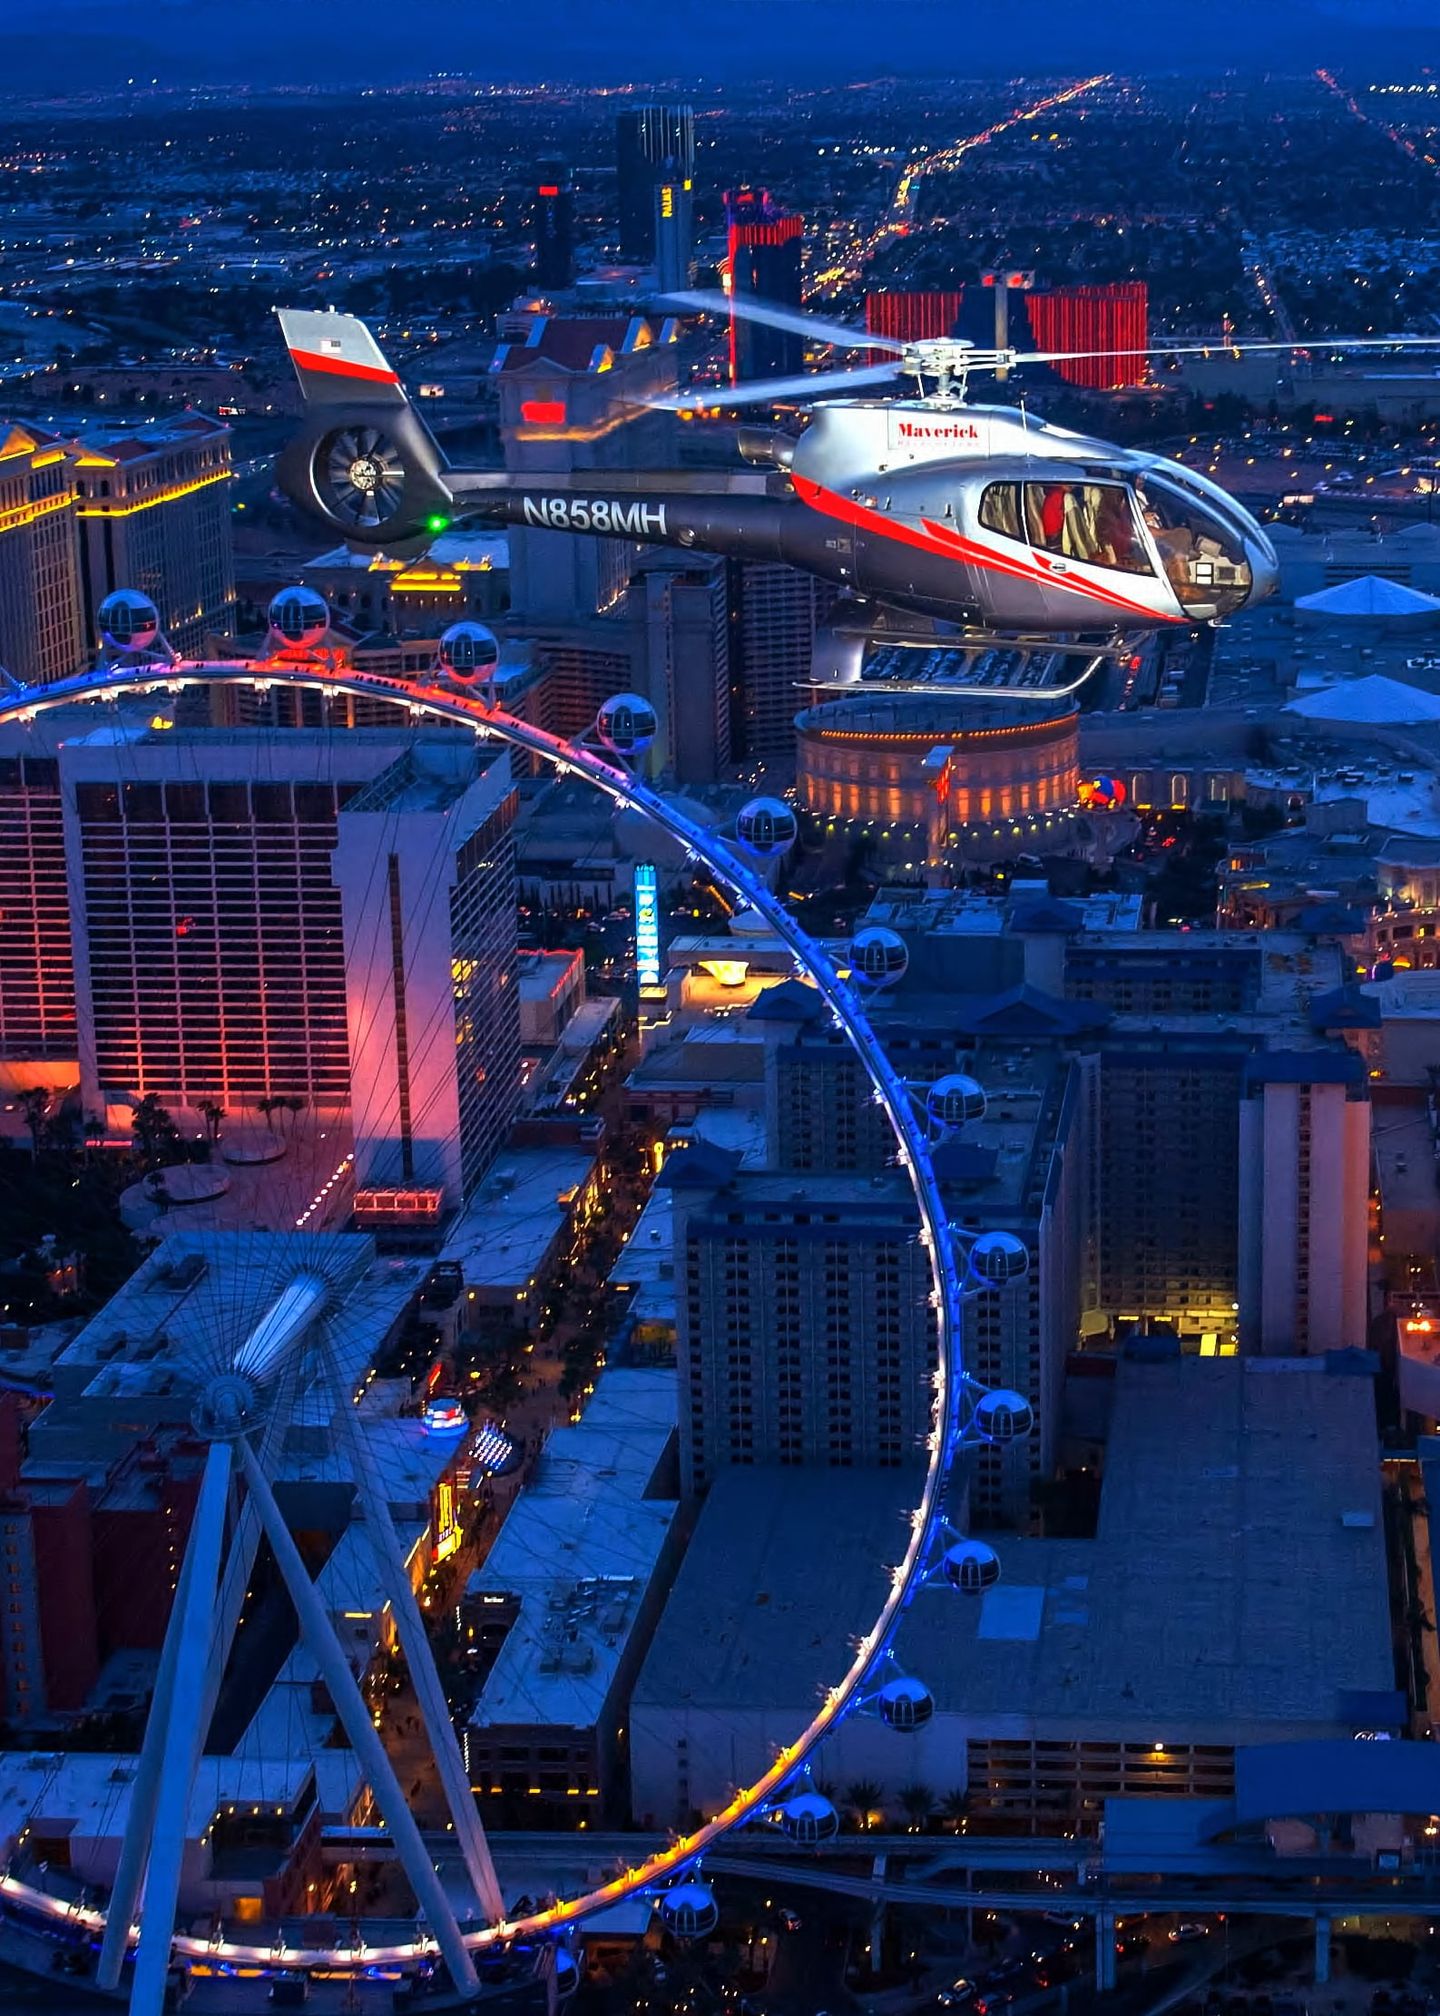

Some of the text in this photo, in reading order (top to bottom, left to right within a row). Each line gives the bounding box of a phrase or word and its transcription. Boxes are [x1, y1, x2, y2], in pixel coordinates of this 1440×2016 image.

[662, 187, 672, 217] PALMS
[899, 423, 978, 438] Maverick
[523, 497, 667, 535] N858MH
